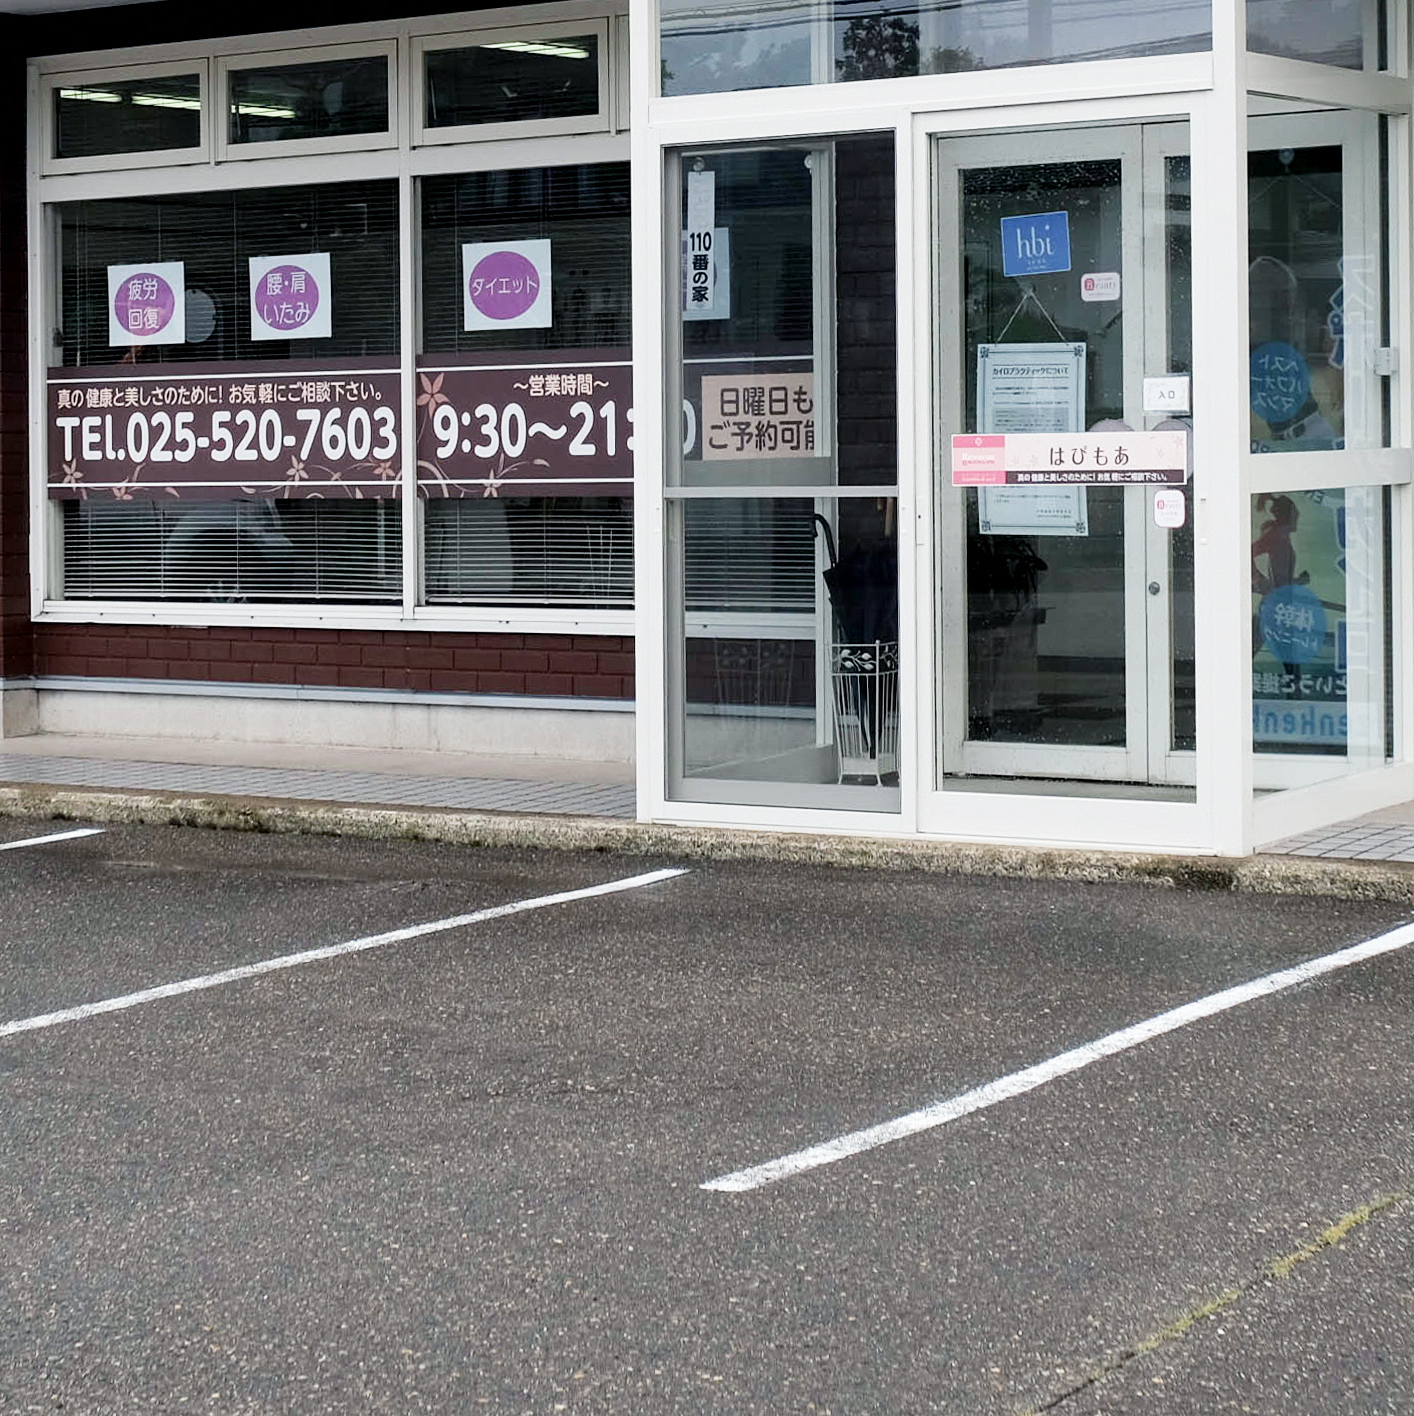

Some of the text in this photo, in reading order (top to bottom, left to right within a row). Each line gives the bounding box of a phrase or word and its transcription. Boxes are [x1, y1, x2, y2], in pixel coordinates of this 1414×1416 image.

[128, 278, 158, 301] 疲労
[472, 275, 538, 297] ダイエット
[128, 308, 160, 330] 回復
[264, 301, 311, 326] いたみ
[1158, 388, 1176, 401] 入口
[1050, 445, 1130, 466] はぴもあ
